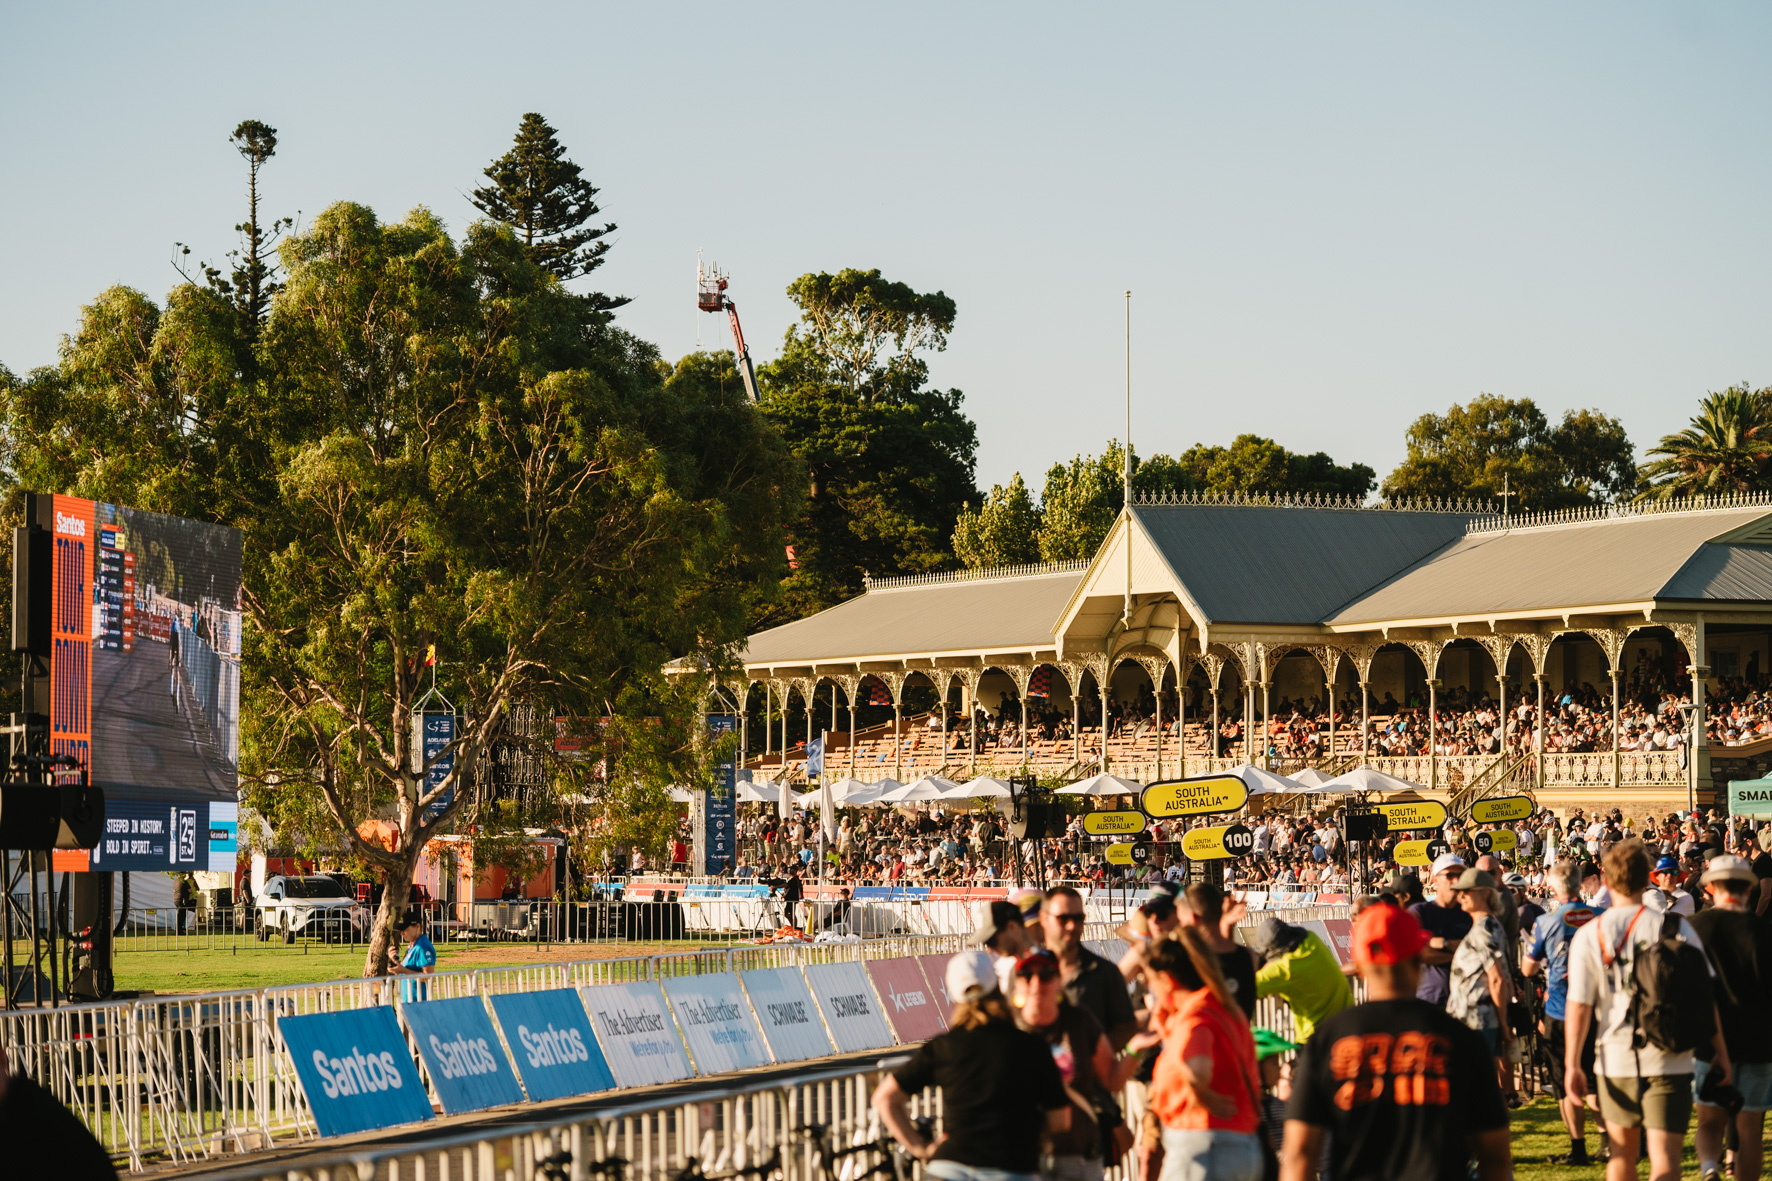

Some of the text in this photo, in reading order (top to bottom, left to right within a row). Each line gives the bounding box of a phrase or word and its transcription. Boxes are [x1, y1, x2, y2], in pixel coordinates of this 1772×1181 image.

[56, 511, 86, 537] Santos
[56, 538, 85, 635] TOUR
[54, 638, 89, 734] DOWN
[1175, 786, 1210, 799] SOUTH
[1738, 790, 1772, 801] SMA
[1165, 796, 1223, 811] AUSTRALIA
[1490, 802, 1512, 810] SOUTH
[1102, 815, 1124, 823] SOUTH
[1389, 807, 1417, 817] SOUTH
[1485, 809, 1519, 819] AUSTRALIA
[106, 818, 165, 835] STEEPED IN HISTORY.
[1387, 816, 1427, 826] USTRALIA
[106, 839, 120, 854] BOLD
[121, 840, 129, 854] IN
[130, 840, 153, 855] SPIRIT.
[1188, 843, 1217, 851] AUSTRALIA
[1193, 837, 1212, 845] SOUTH
[1225, 832, 1252, 848] 100
[1478, 837, 1490, 847] 50
[1134, 848, 1146, 858] 50
[1431, 845, 1447, 857] 75
[830, 993, 870, 1018] SCHWALBE
[903, 990, 927, 1008] LEGEND
[679, 998, 742, 1026] The Advertiser
[767, 1000, 809, 1026] SCHWALBE
[598, 1008, 665, 1037] The Advertiser
[517, 1022, 589, 1069] Santos
[429, 1033, 498, 1080] Santos
[312, 1045, 403, 1099] Santos
